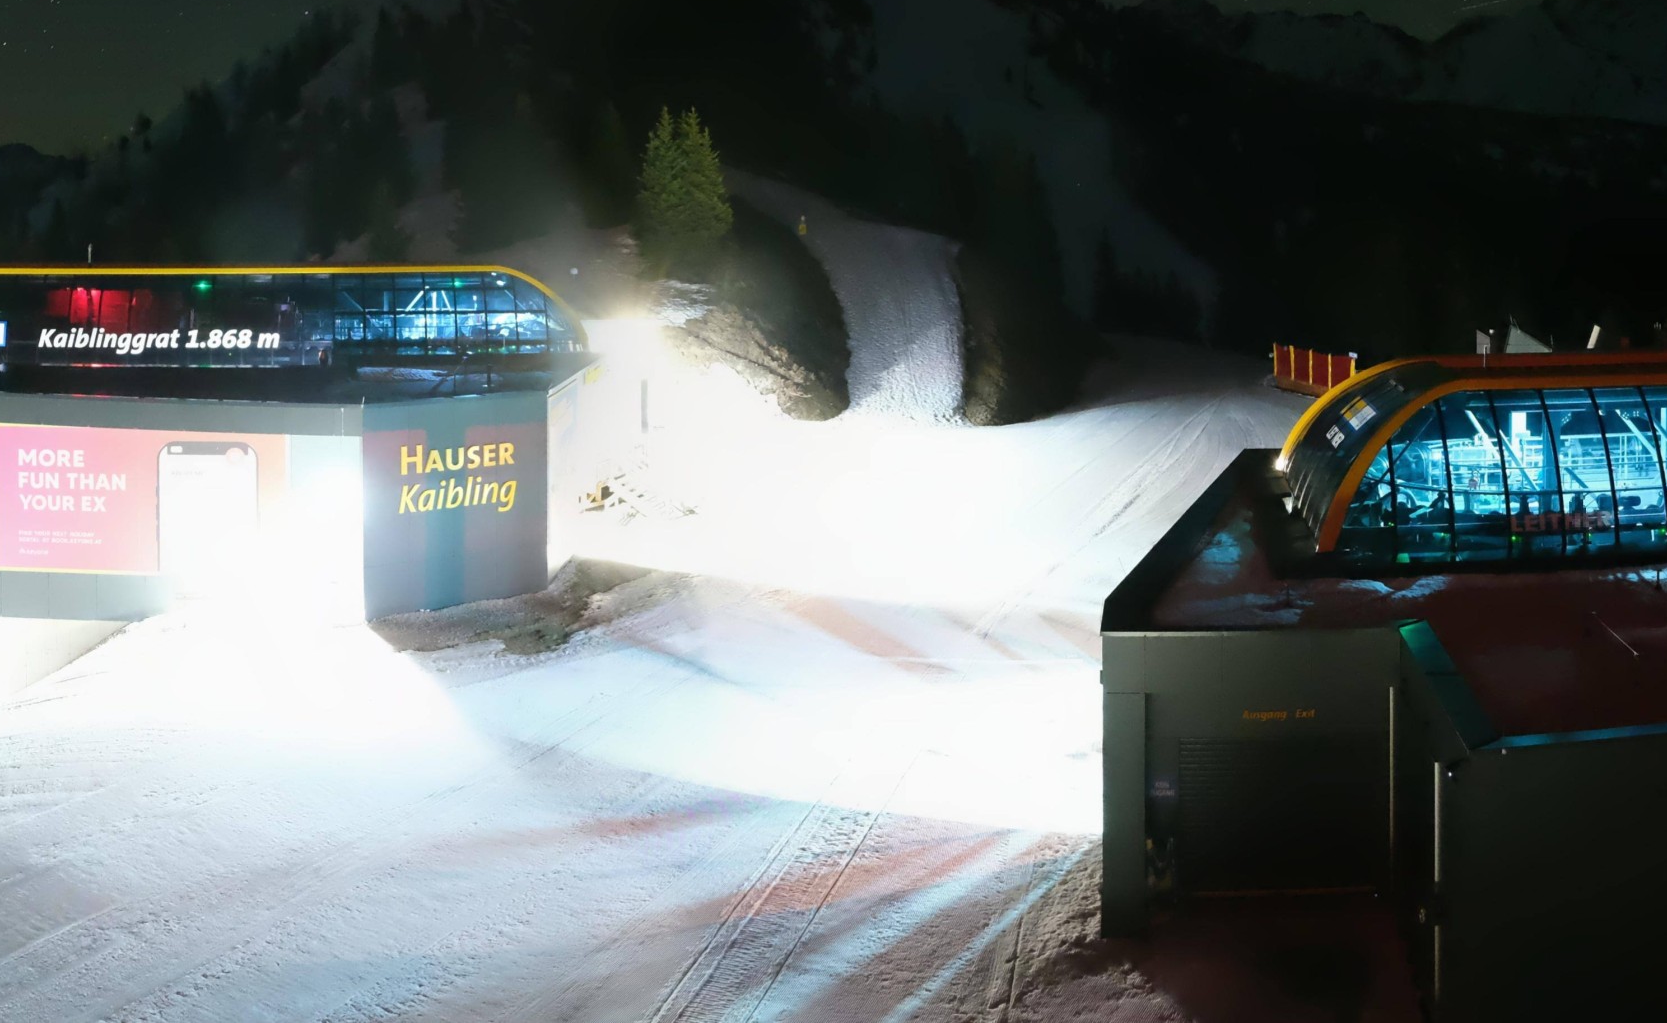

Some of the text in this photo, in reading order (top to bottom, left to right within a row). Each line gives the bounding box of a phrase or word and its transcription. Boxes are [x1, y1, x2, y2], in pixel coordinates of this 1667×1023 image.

[37, 328, 280, 354] Kaiblinggrat 1.868 m
[17, 448, 85, 468] MORE
[399, 442, 516, 476] HAUSER
[17, 471, 127, 491] FUN THAN
[18, 494, 107, 512] YOUR EX
[398, 475, 518, 514] Kaibling
[1242, 708, 1316, 722] Ausgang Exit
